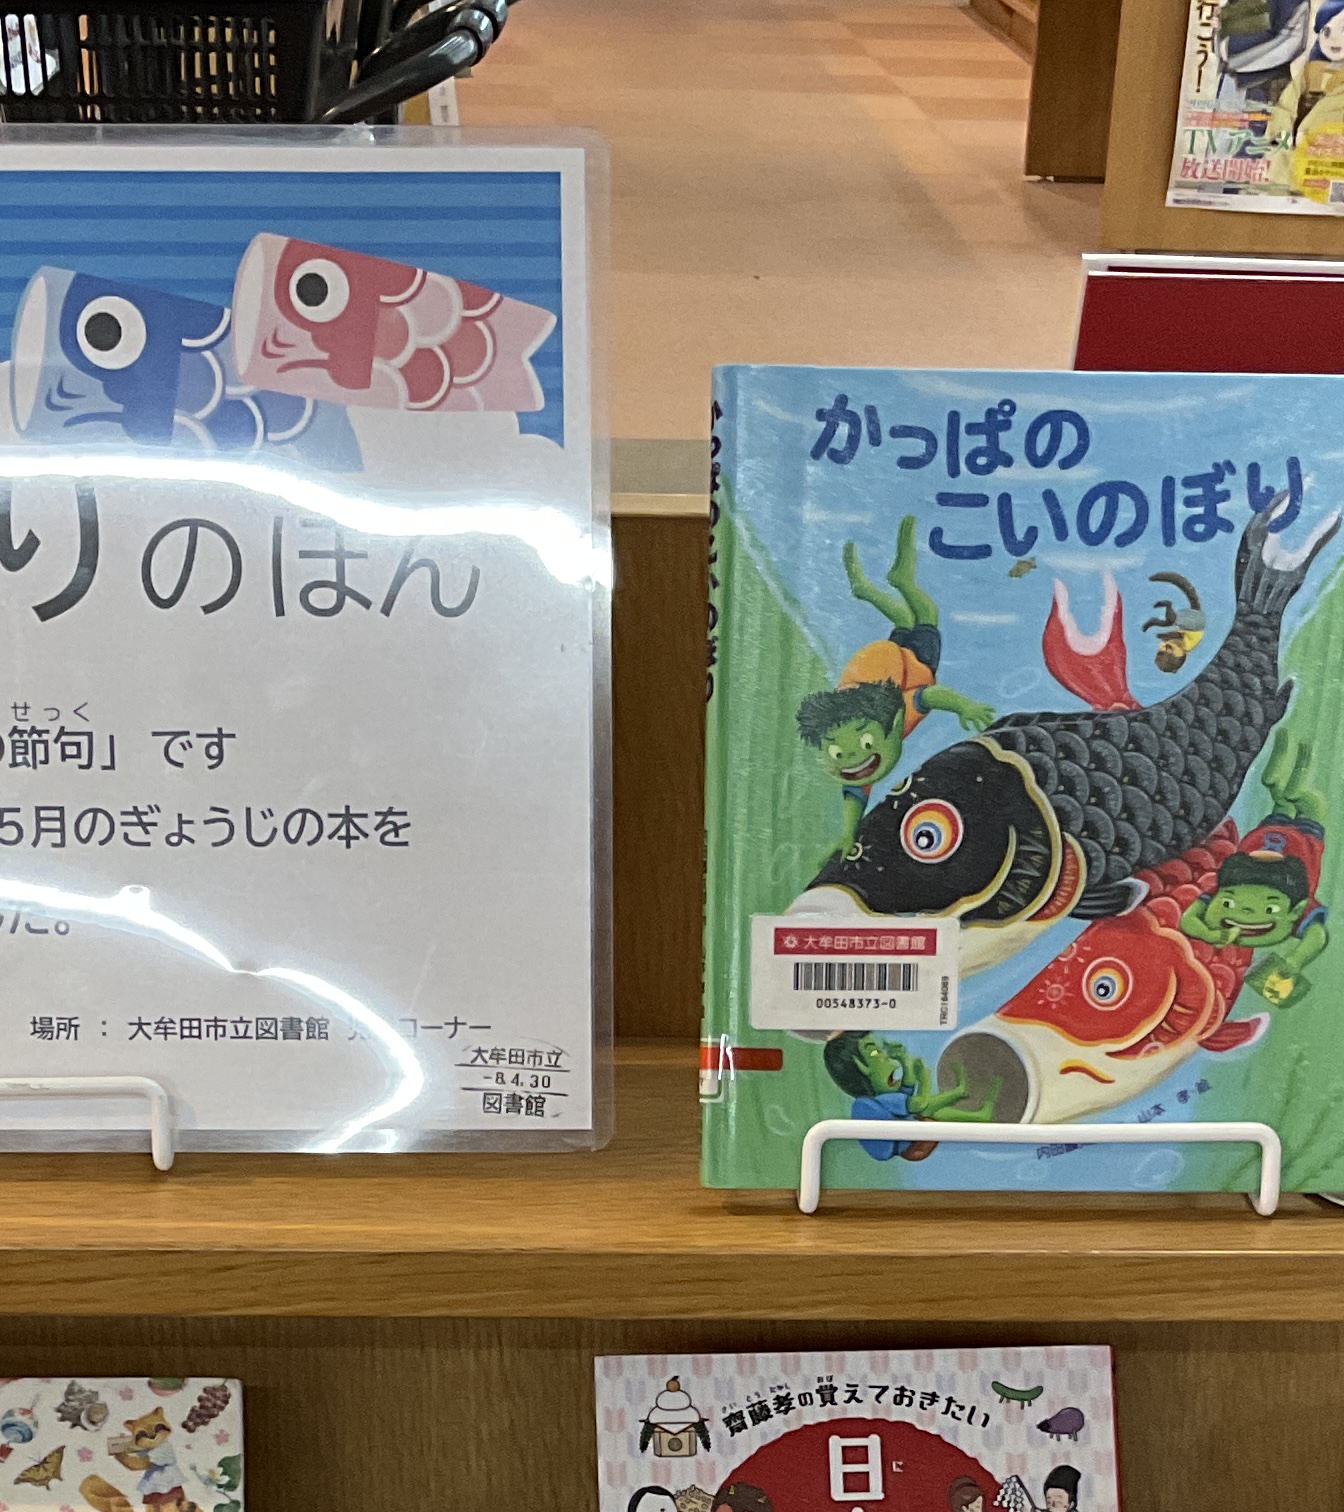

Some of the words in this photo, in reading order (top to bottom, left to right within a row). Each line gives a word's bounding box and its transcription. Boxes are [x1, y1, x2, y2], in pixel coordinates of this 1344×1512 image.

[808, 394, 1091, 480] かっぱの
[927, 455, 1306, 561] こいのぼり
[141, 515, 479, 618] のほん
[11, 702, 90, 722] せっく
[803, 935, 927, 951] 大牟田市立図書館
[815, 998, 897, 1010] 00548373-0
[30, 1016, 80, 1042] 場所
[127, 1016, 330, 1042] 大牟田市立図書館
[470, 1045, 563, 1068] 大牟田市立
[483, 1092, 546, 1118] 図書館
